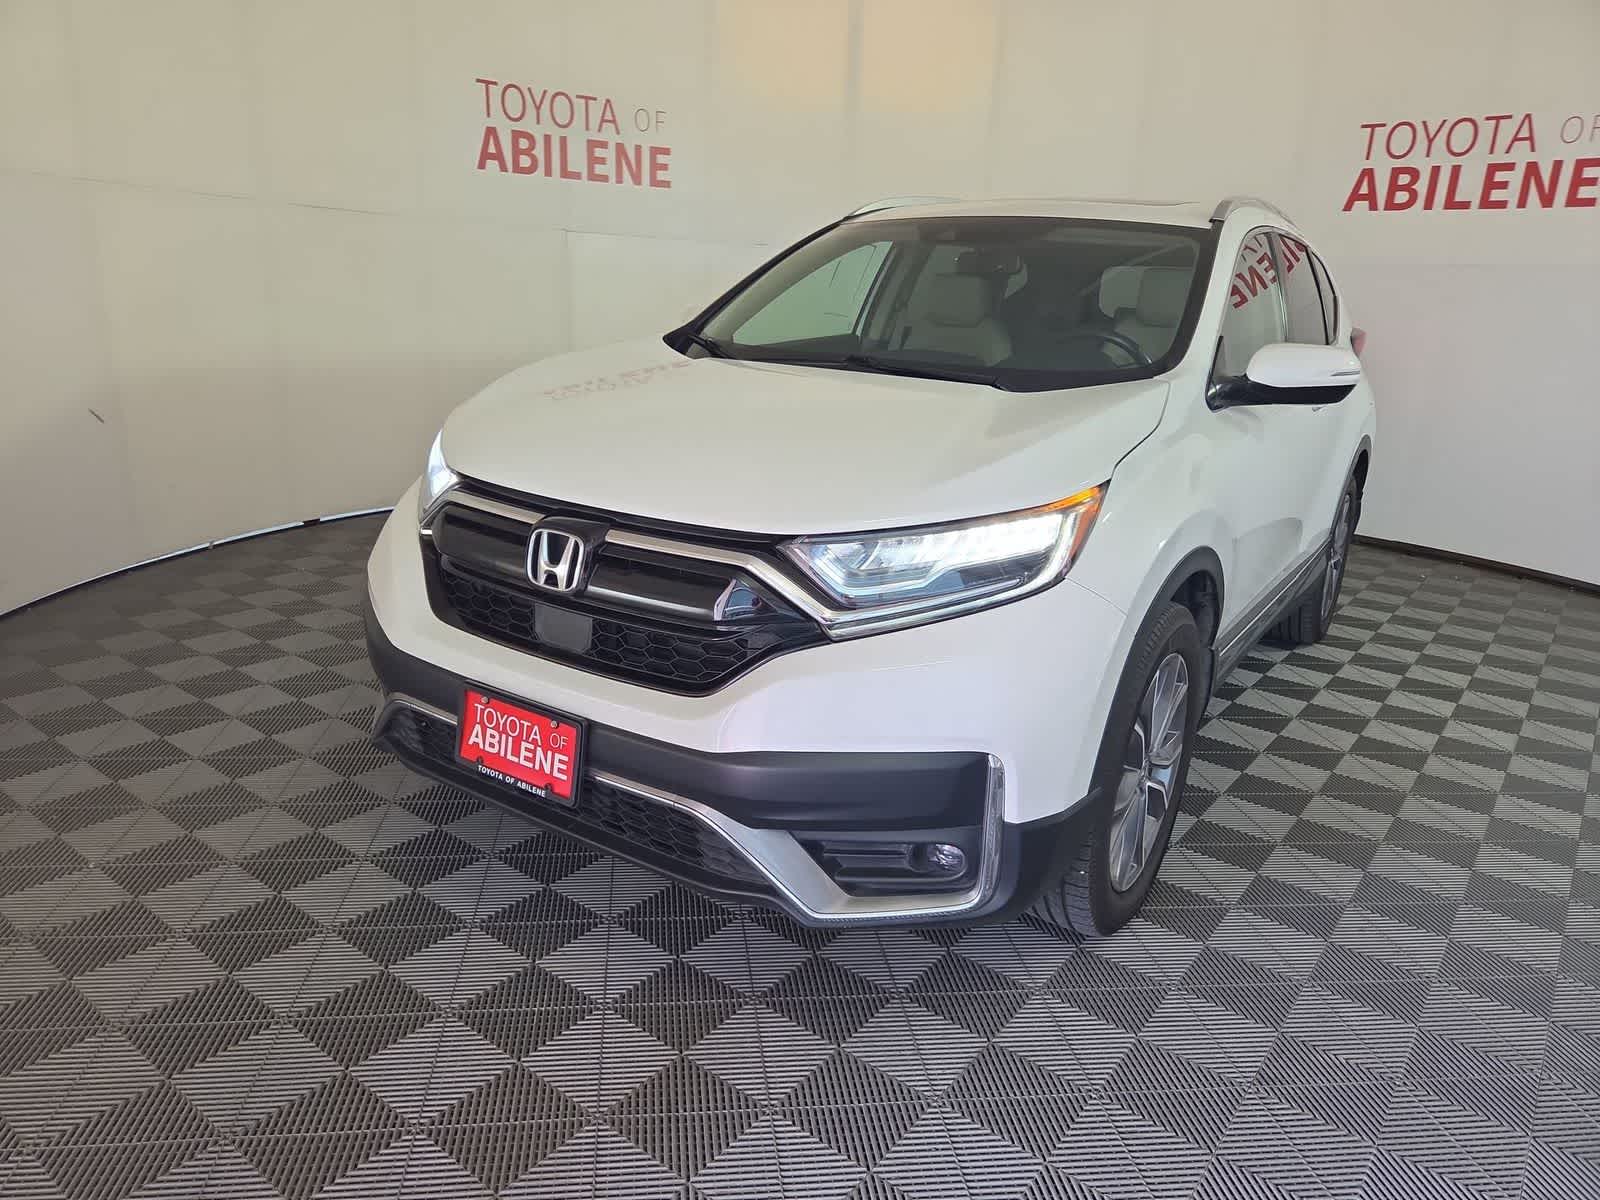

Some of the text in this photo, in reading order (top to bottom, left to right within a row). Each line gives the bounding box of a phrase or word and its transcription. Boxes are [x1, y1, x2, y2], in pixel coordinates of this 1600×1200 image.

[475, 78, 667, 135] TOYOTA OF
[476, 126, 672, 189] ABILENE
[1360, 112, 1536, 161] TOYOTA
[1342, 157, 1600, 212] ABILENE
[468, 723, 569, 781] ABILENE
[474, 703, 569, 750] TOYOTA OF
[478, 764, 546, 798] TOYOTA OF ABILENE
